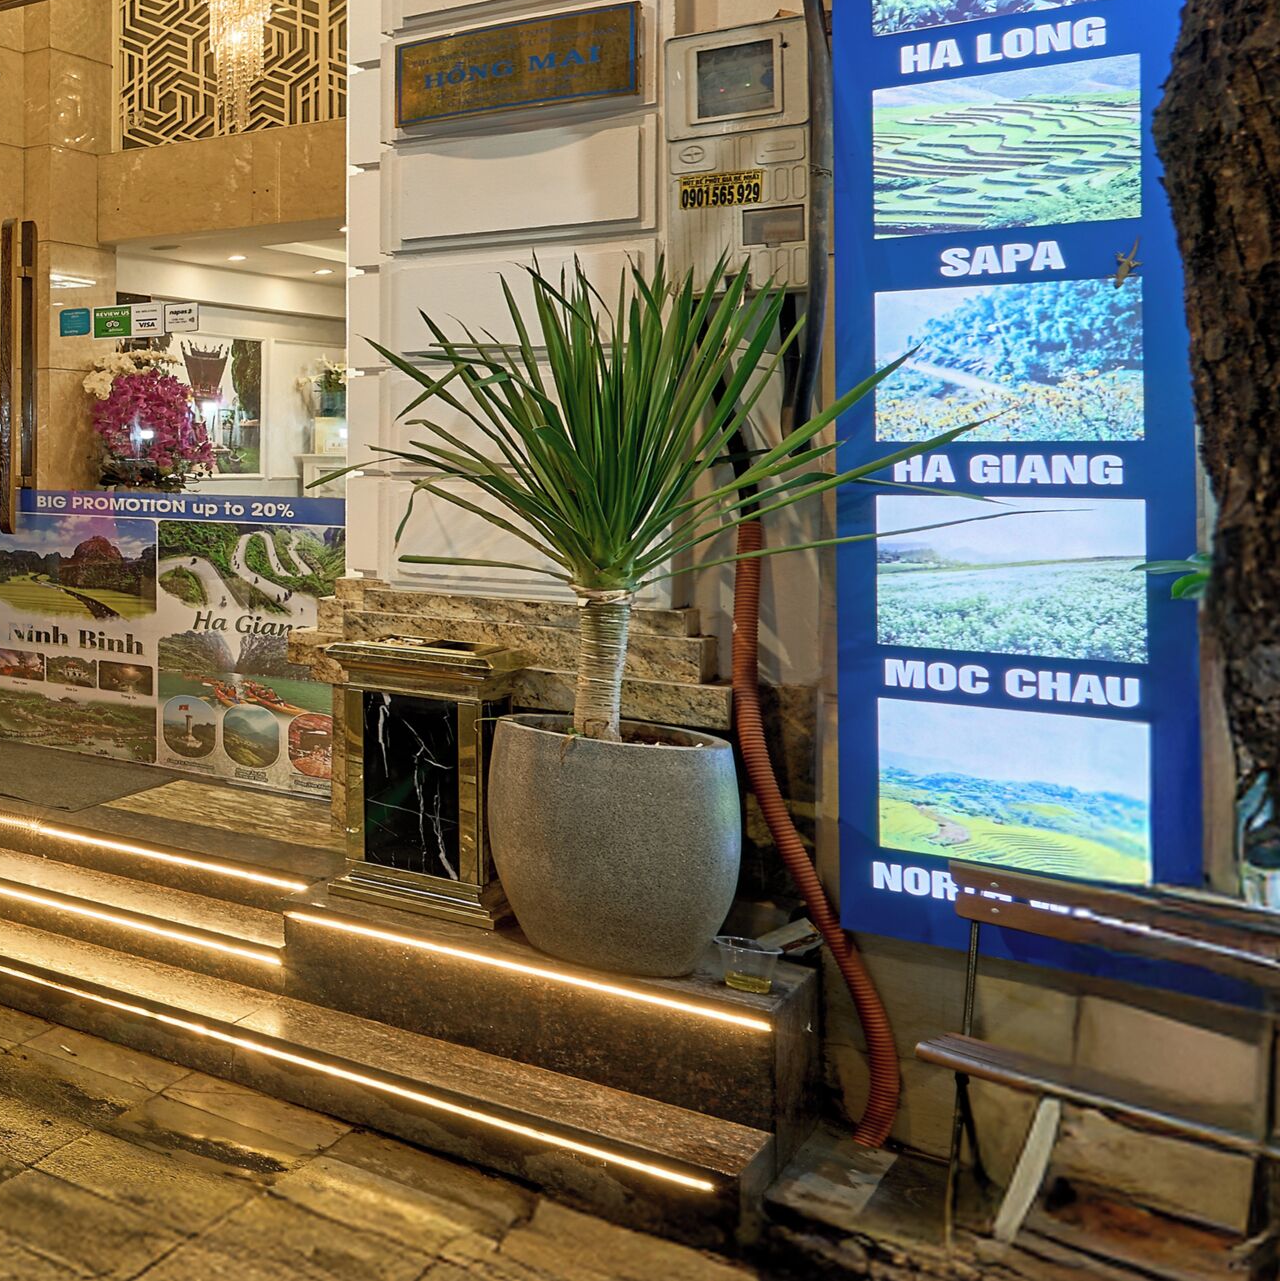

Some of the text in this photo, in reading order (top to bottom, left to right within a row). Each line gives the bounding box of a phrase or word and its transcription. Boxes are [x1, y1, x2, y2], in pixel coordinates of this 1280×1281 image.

[528, 45, 601, 72] MAI
[899, 17, 1107, 75] HA LONG
[940, 241, 1066, 278] SAPA
[892, 454, 1124, 486] HA GIANG
[36, 495, 295, 519] BIG PROMOTION up to 20%
[192, 610, 228, 631] Ha
[8, 622, 144, 655] Ninh Binh
[884, 658, 1140, 709] MOC CHAU
